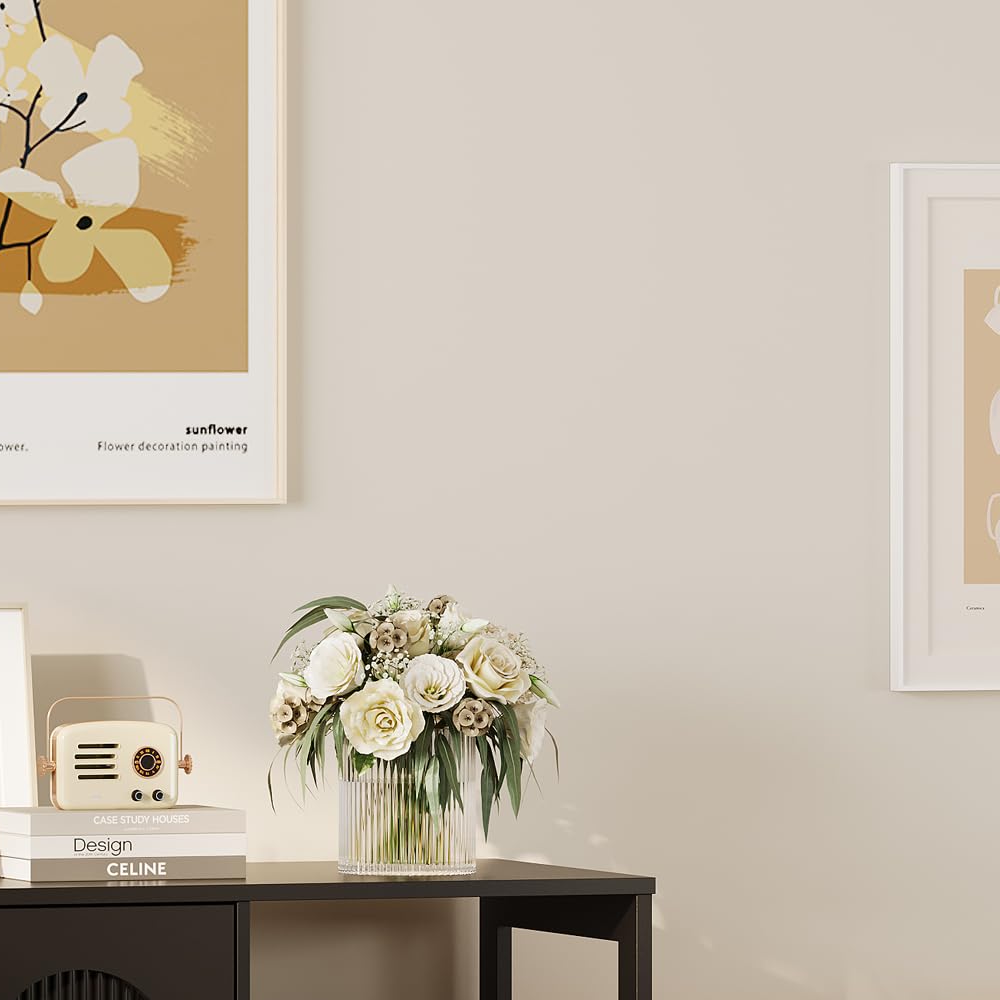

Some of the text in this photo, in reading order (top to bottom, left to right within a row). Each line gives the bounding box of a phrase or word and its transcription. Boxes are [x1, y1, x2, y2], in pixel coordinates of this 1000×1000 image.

[185, 424, 248, 435] sunflower
[97, 441, 248, 454] Flower decoration painting
[93, 814, 190, 825] CASE STUDY HOUSES
[73, 837, 133, 857] Design
[106, 862, 167, 877] CELINE
